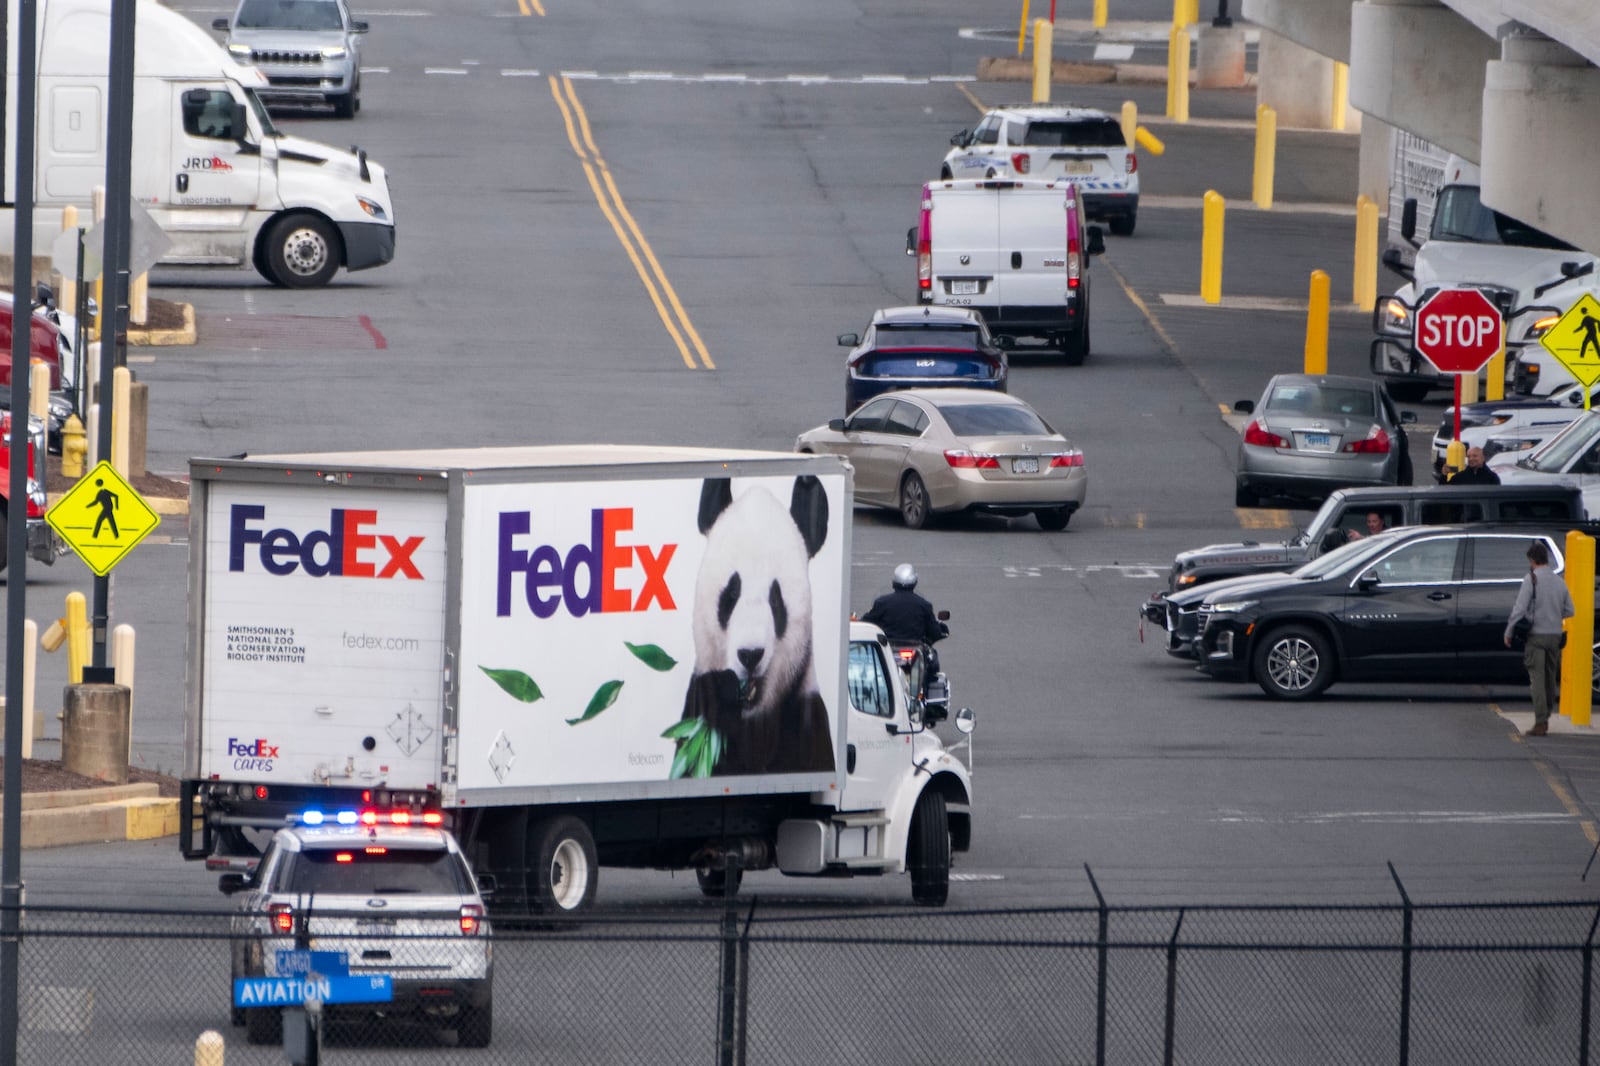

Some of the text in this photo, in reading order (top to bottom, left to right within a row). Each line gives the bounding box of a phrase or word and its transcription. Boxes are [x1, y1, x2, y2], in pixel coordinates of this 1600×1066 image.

[182, 157, 212, 169] JRD
[1423, 314, 1495, 347] STOP
[229, 503, 426, 580] FedEx
[496, 507, 679, 619] FedEx
[227, 626, 295, 636] SMITHSONIAN'S
[227, 635, 294, 645] NATIONAL ZOO
[236, 644, 306, 654] CONSERVATION
[342, 632, 419, 651] fedex.com
[227, 653, 305, 663] BIOLOGY INSTITUTE
[228, 738, 279, 758] FedEx
[233, 758, 273, 772] cares
[276, 952, 311, 974] CARGO
[241, 977, 385, 1004] AVIATION DR
